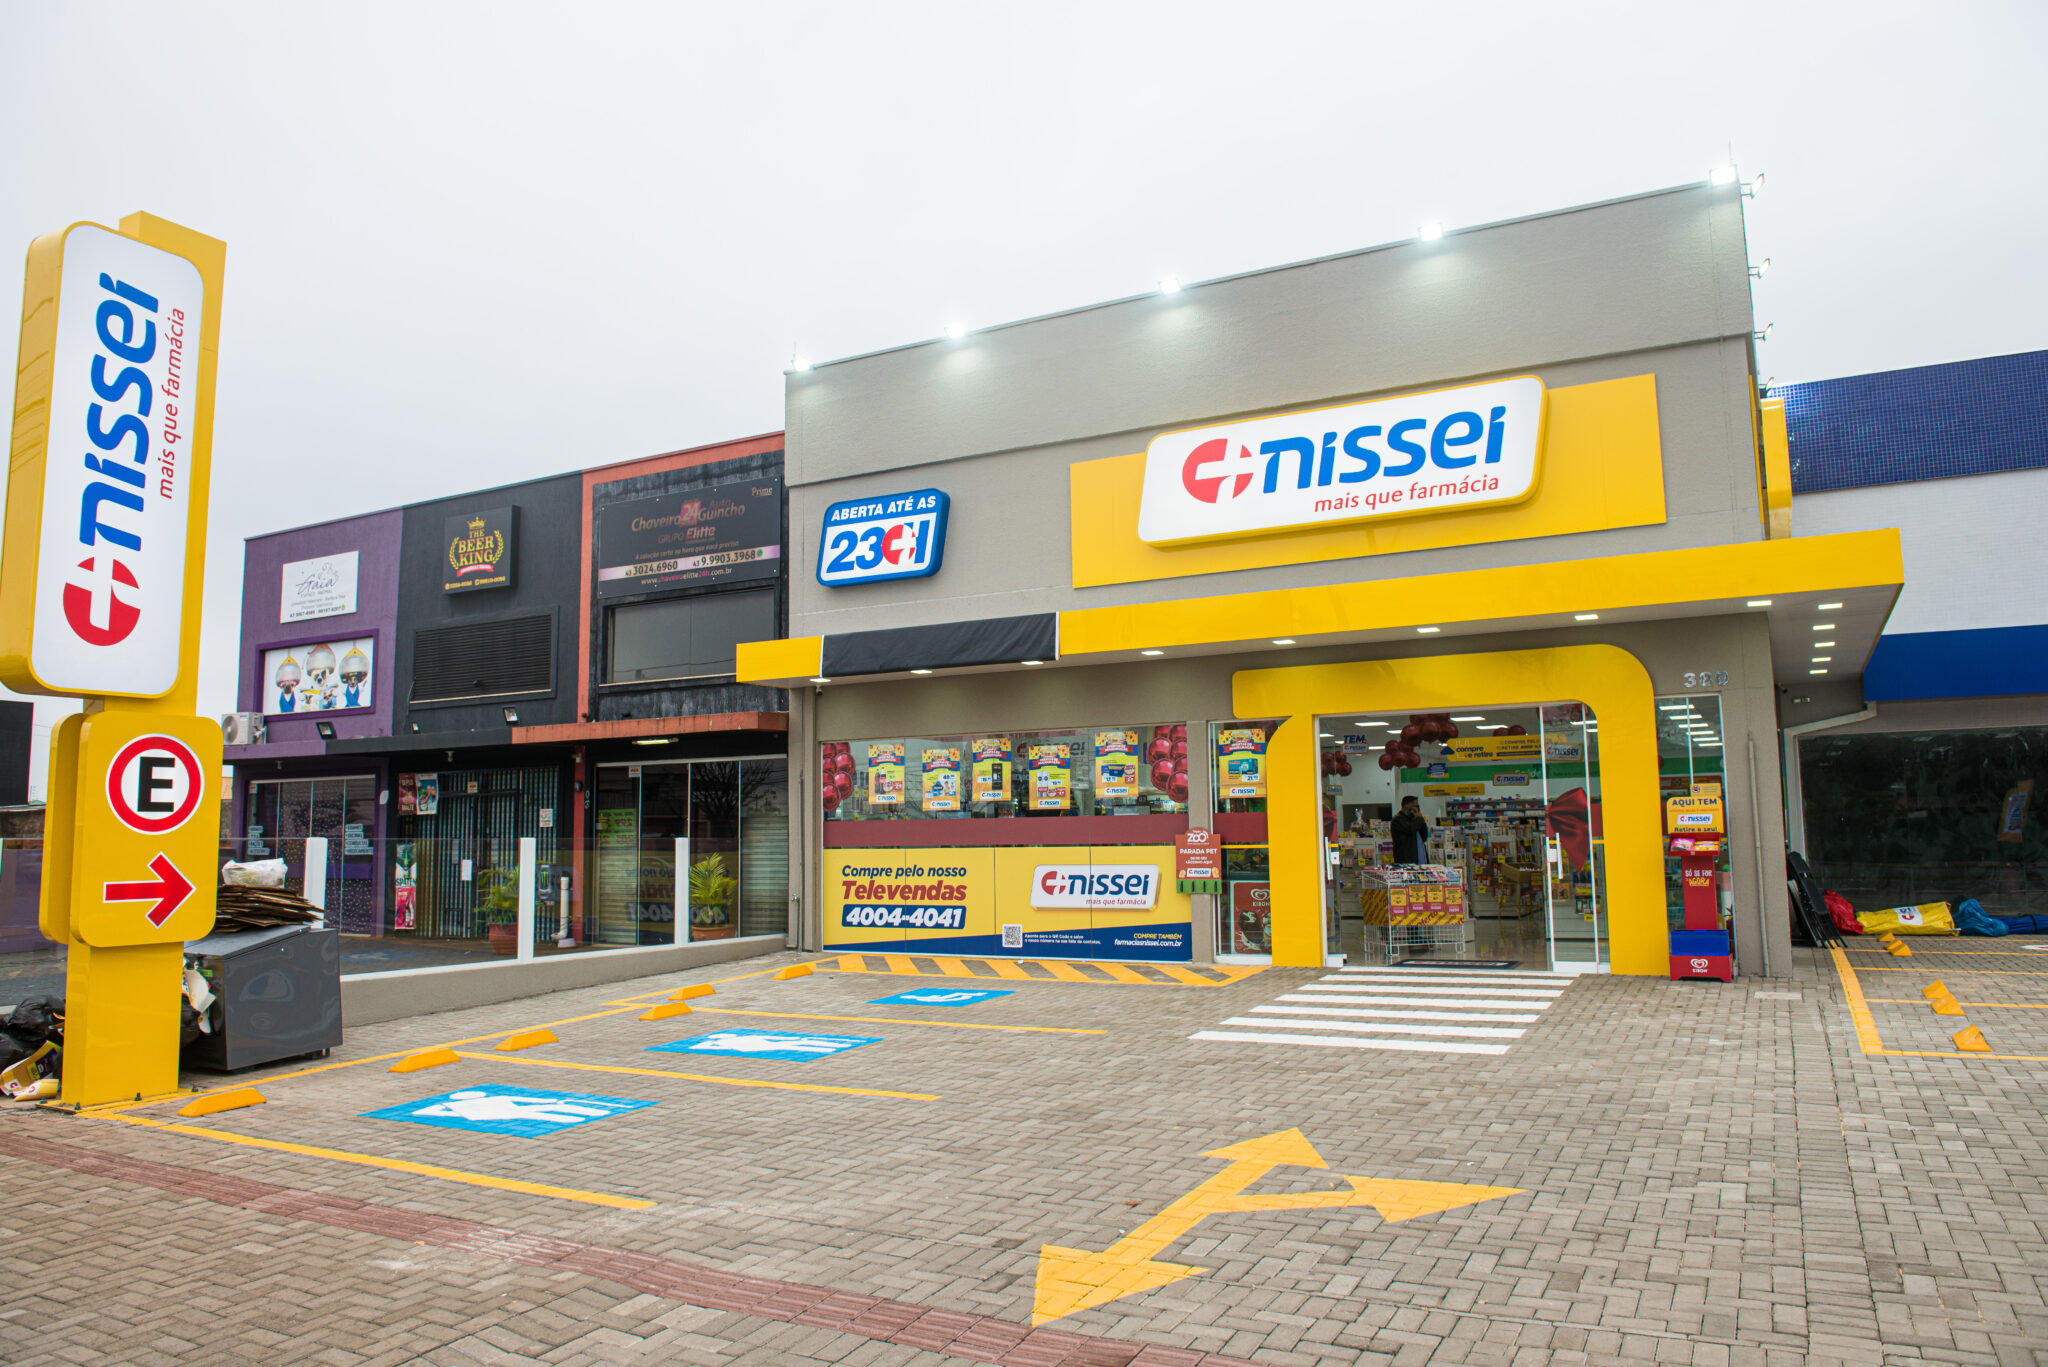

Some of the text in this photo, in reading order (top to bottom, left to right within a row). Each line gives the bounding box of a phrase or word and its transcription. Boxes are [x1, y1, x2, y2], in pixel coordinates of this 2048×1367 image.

[79, 272, 159, 552] nissei
[157, 308, 185, 500] mais que farmácia
[1259, 405, 1506, 494] nissei
[751, 486, 773, 496] Prime
[1314, 475, 1499, 513] mais que farmácia
[831, 496, 936, 521] ABERTA ATÉ AS
[631, 504, 746, 532] Chaveiro 24 Guincho
[469, 529, 485, 538] THE
[458, 536, 495, 553] BEER
[459, 549, 494, 567] KING
[701, 550, 756, 566] 9.9903.3968
[633, 560, 678, 576] 3024.6960
[1683, 670, 1729, 688] 380
[1343, 734, 1366, 743] TEM
[137, 756, 175, 812] E
[1672, 798, 1695, 807] AQUI
[842, 864, 967, 879] Compre pelo nosso
[1685, 868, 1692, 876] SÓ
[842, 880, 967, 901] Televendas
[1068, 874, 1149, 895] nissei
[1117, 897, 1146, 905] farmácia
[846, 907, 962, 927] 4004-4041
[1114, 938, 1182, 947] farmaciasnissei.com.br
[1158, 932, 1182, 940] TAMBÉM
